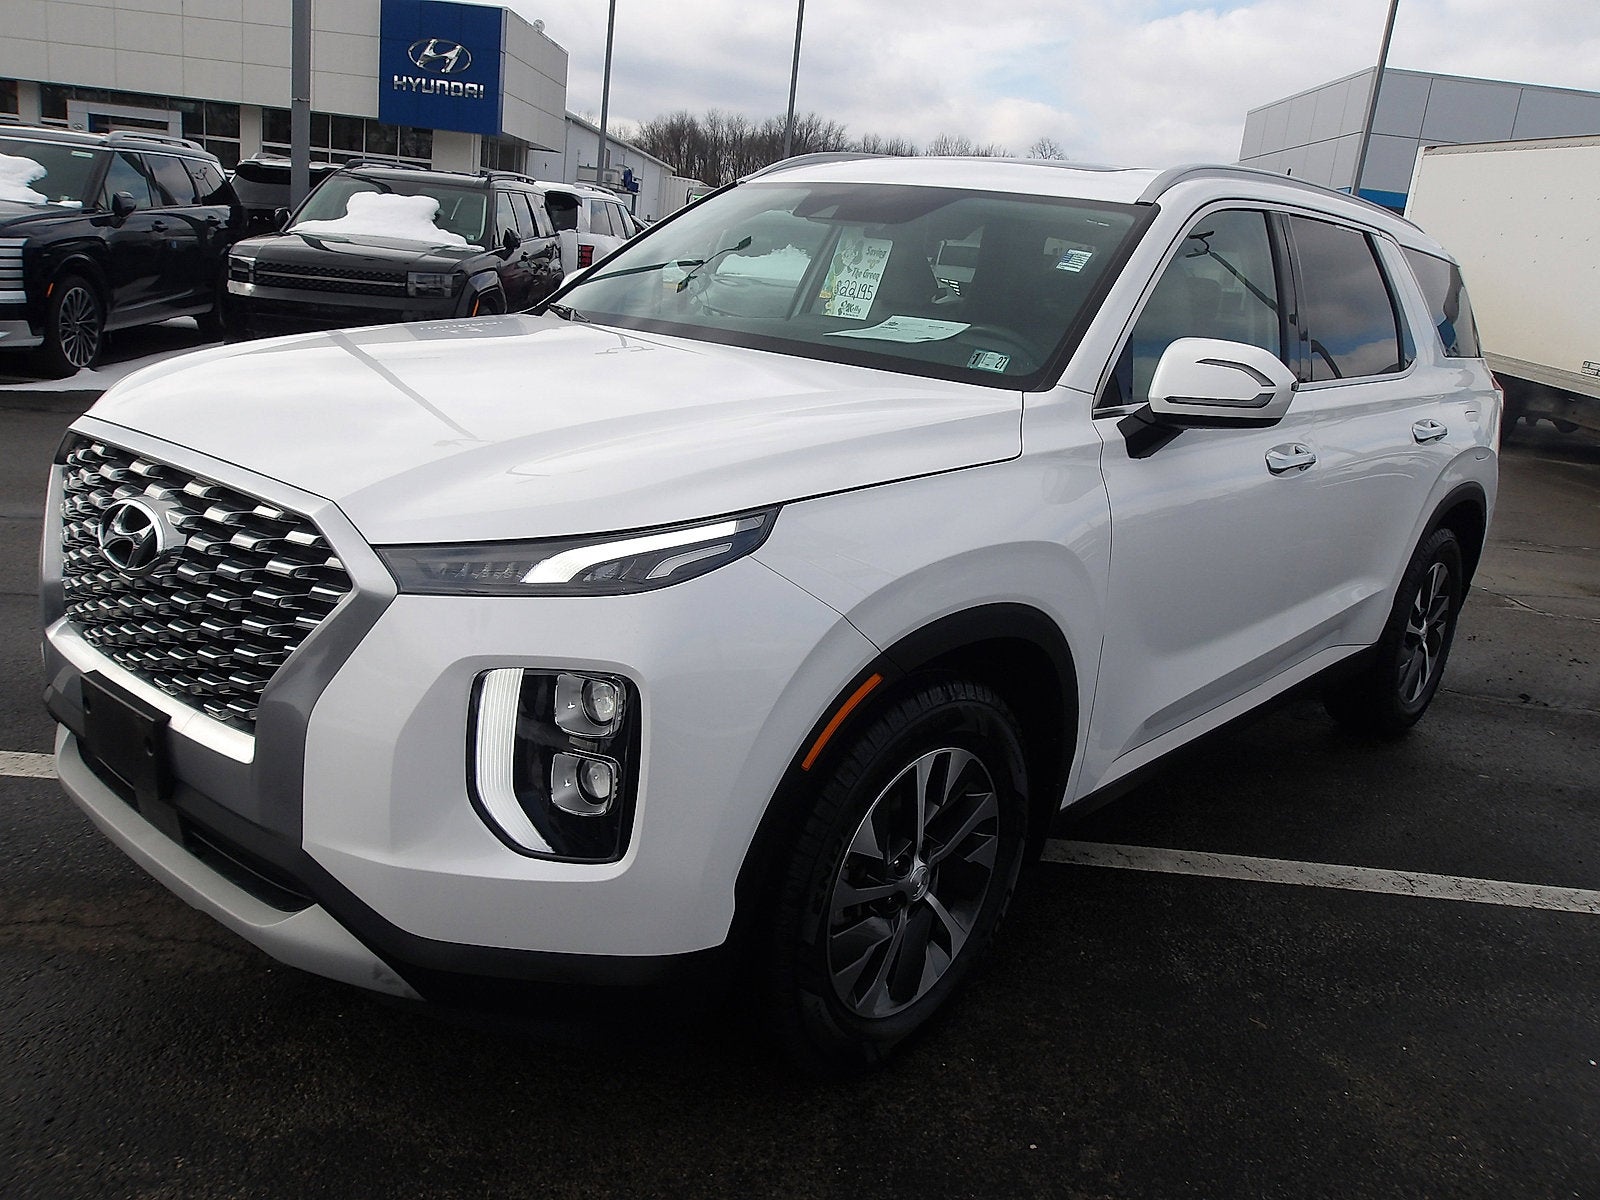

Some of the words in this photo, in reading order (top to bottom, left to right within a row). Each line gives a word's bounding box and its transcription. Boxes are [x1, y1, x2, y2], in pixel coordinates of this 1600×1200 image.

[393, 75, 484, 99] HYUNDAI
[852, 267, 862, 279] The
[994, 356, 1008, 370] 27
